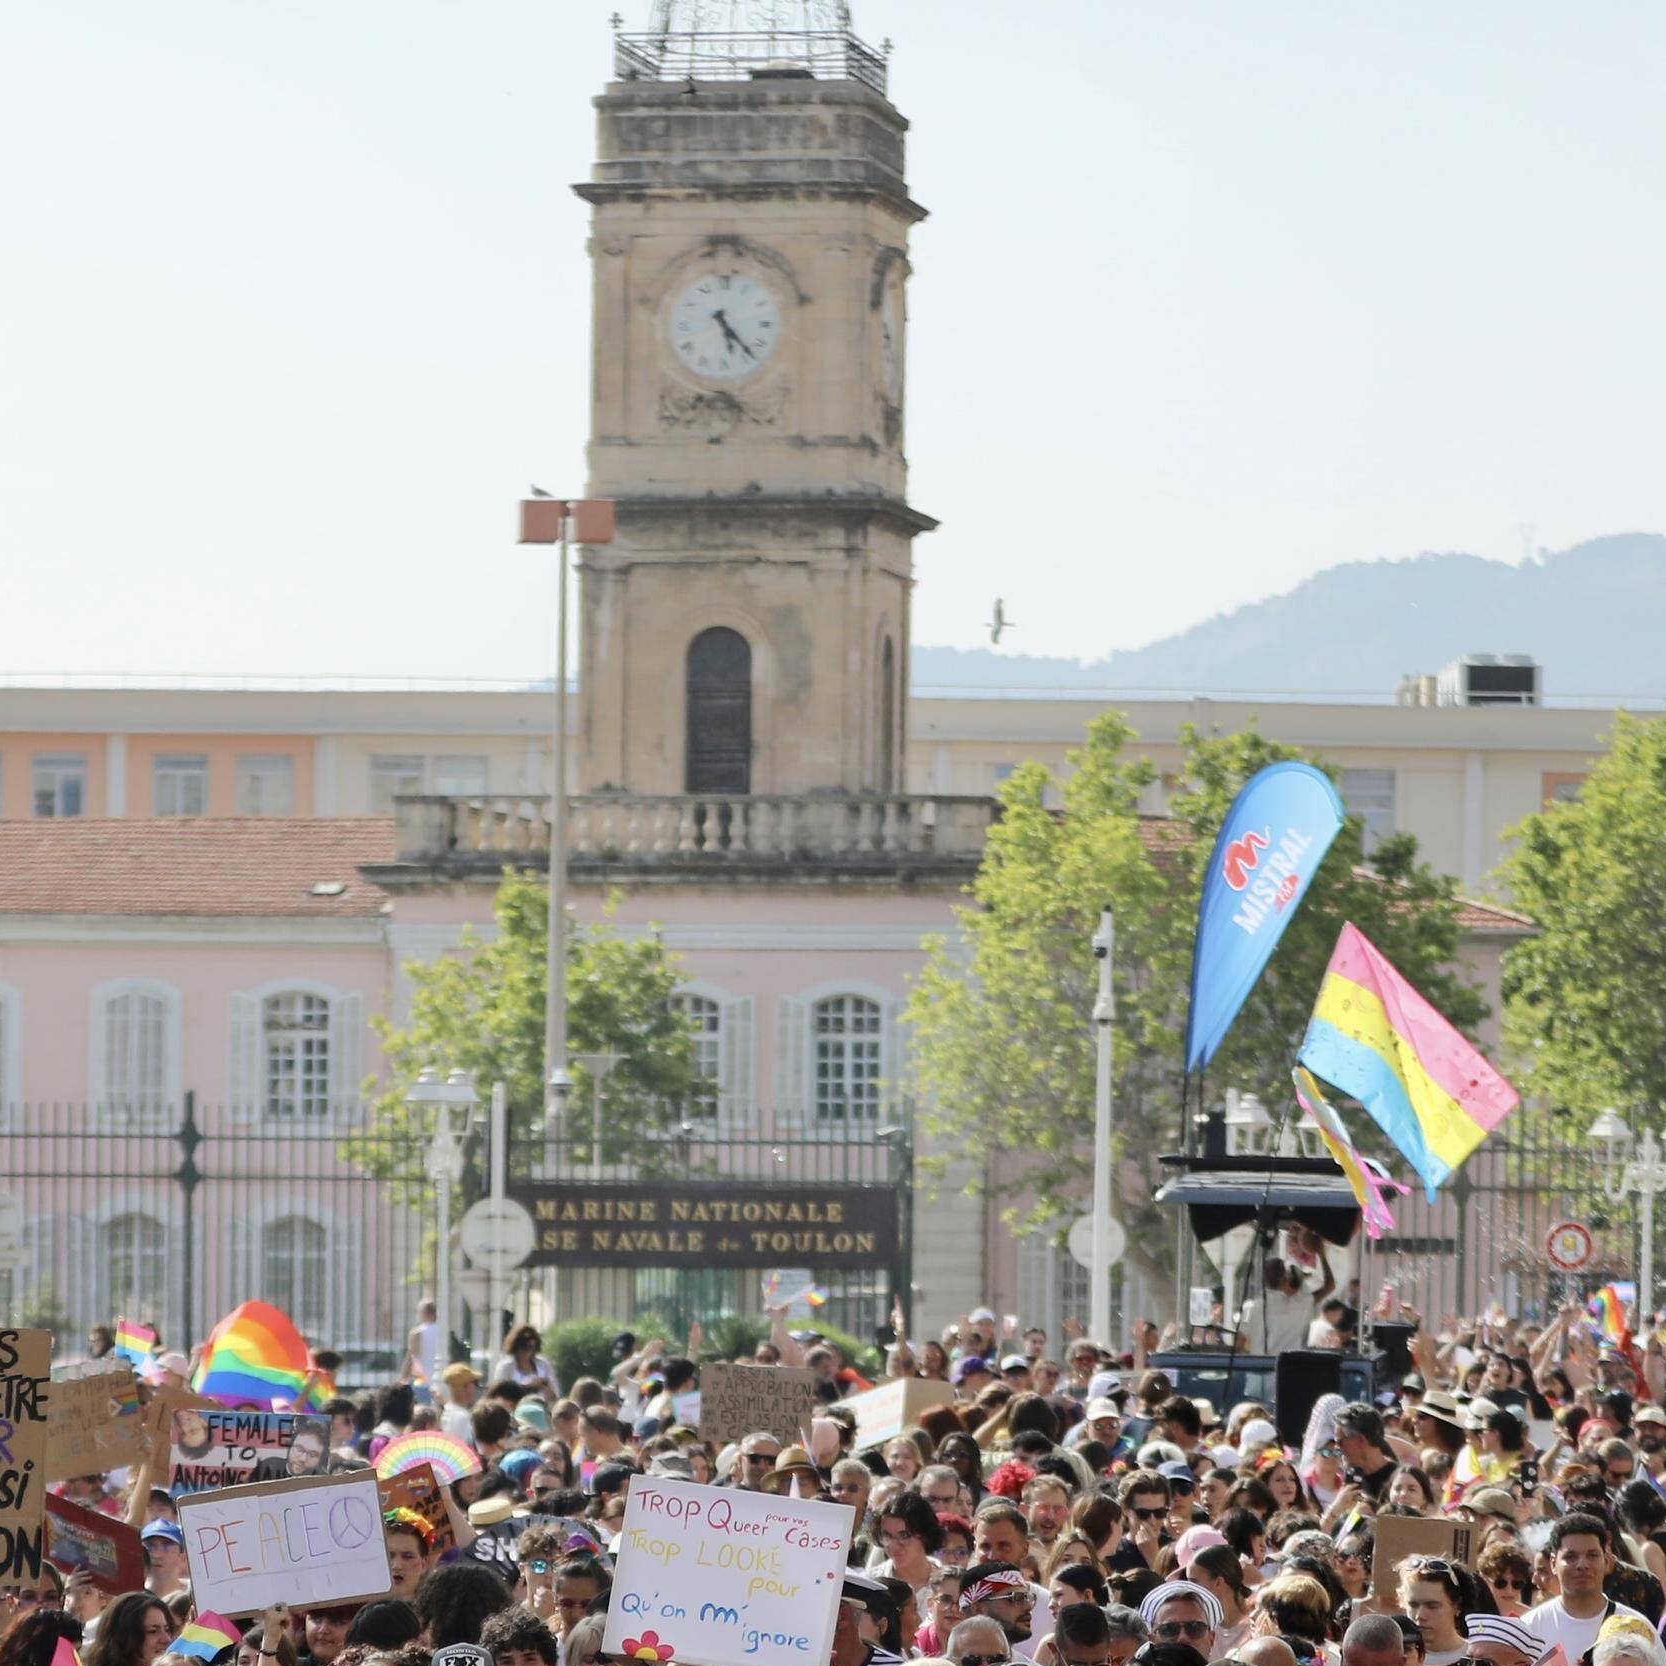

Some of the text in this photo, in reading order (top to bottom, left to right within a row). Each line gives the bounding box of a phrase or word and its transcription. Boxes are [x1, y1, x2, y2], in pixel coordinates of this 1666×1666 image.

[1232, 828, 1313, 935] MISTRAL
[536, 1200, 845, 1223] MARINE NATIONALE
[592, 1231, 705, 1253] NAVALE
[751, 1231, 877, 1253] TOULON
[207, 1415, 294, 1448] FEMALE
[225, 1444, 257, 1461] TO
[636, 1490, 769, 1535] TROP Queer
[765, 1512, 810, 1528] pour vos
[196, 1501, 331, 1579] PEACE
[474, 1536, 520, 1562] SH
[785, 1527, 842, 1551] Cases
[748, 1576, 800, 1599] pour
[741, 1623, 810, 1653] ignore
